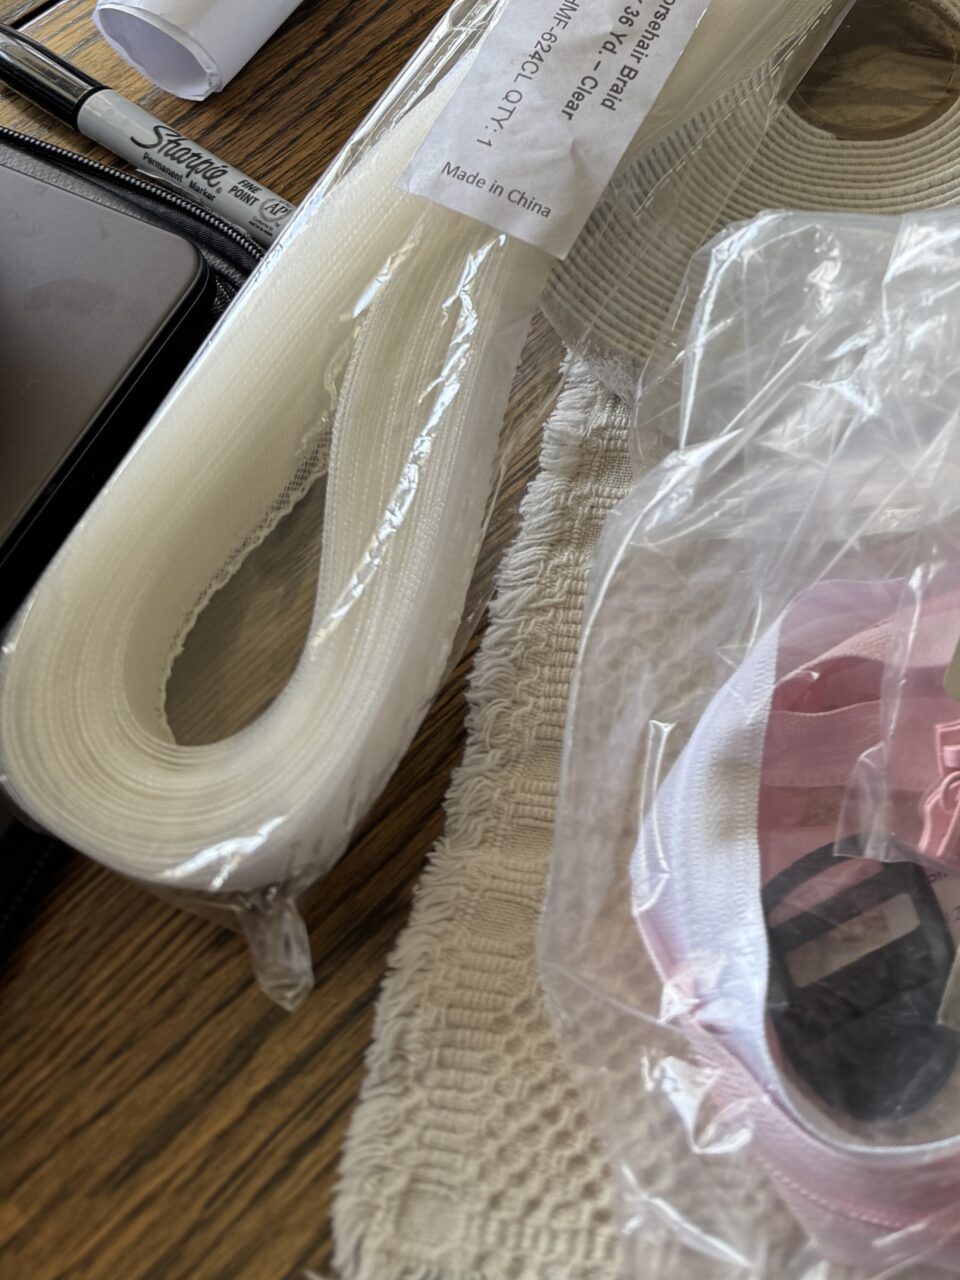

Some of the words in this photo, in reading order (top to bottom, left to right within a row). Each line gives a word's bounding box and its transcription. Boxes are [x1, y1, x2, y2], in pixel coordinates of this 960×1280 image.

[618, 5, 640, 29] 36
[597, 32, 625, 56] Yd.
[561, 74, 599, 121] Clear
[600, 64, 639, 111] Braid
[130, 125, 229, 188] Sharpie
[143, 152, 185, 183] Permanent
[188, 180, 217, 202] Marker
[237, 179, 262, 194] FINE
[441, 161, 487, 189] Made
[488, 179, 504, 197] in
[507, 188, 552, 219] China
[228, 185, 260, 207] POINT
[264, 201, 289, 218] AP
